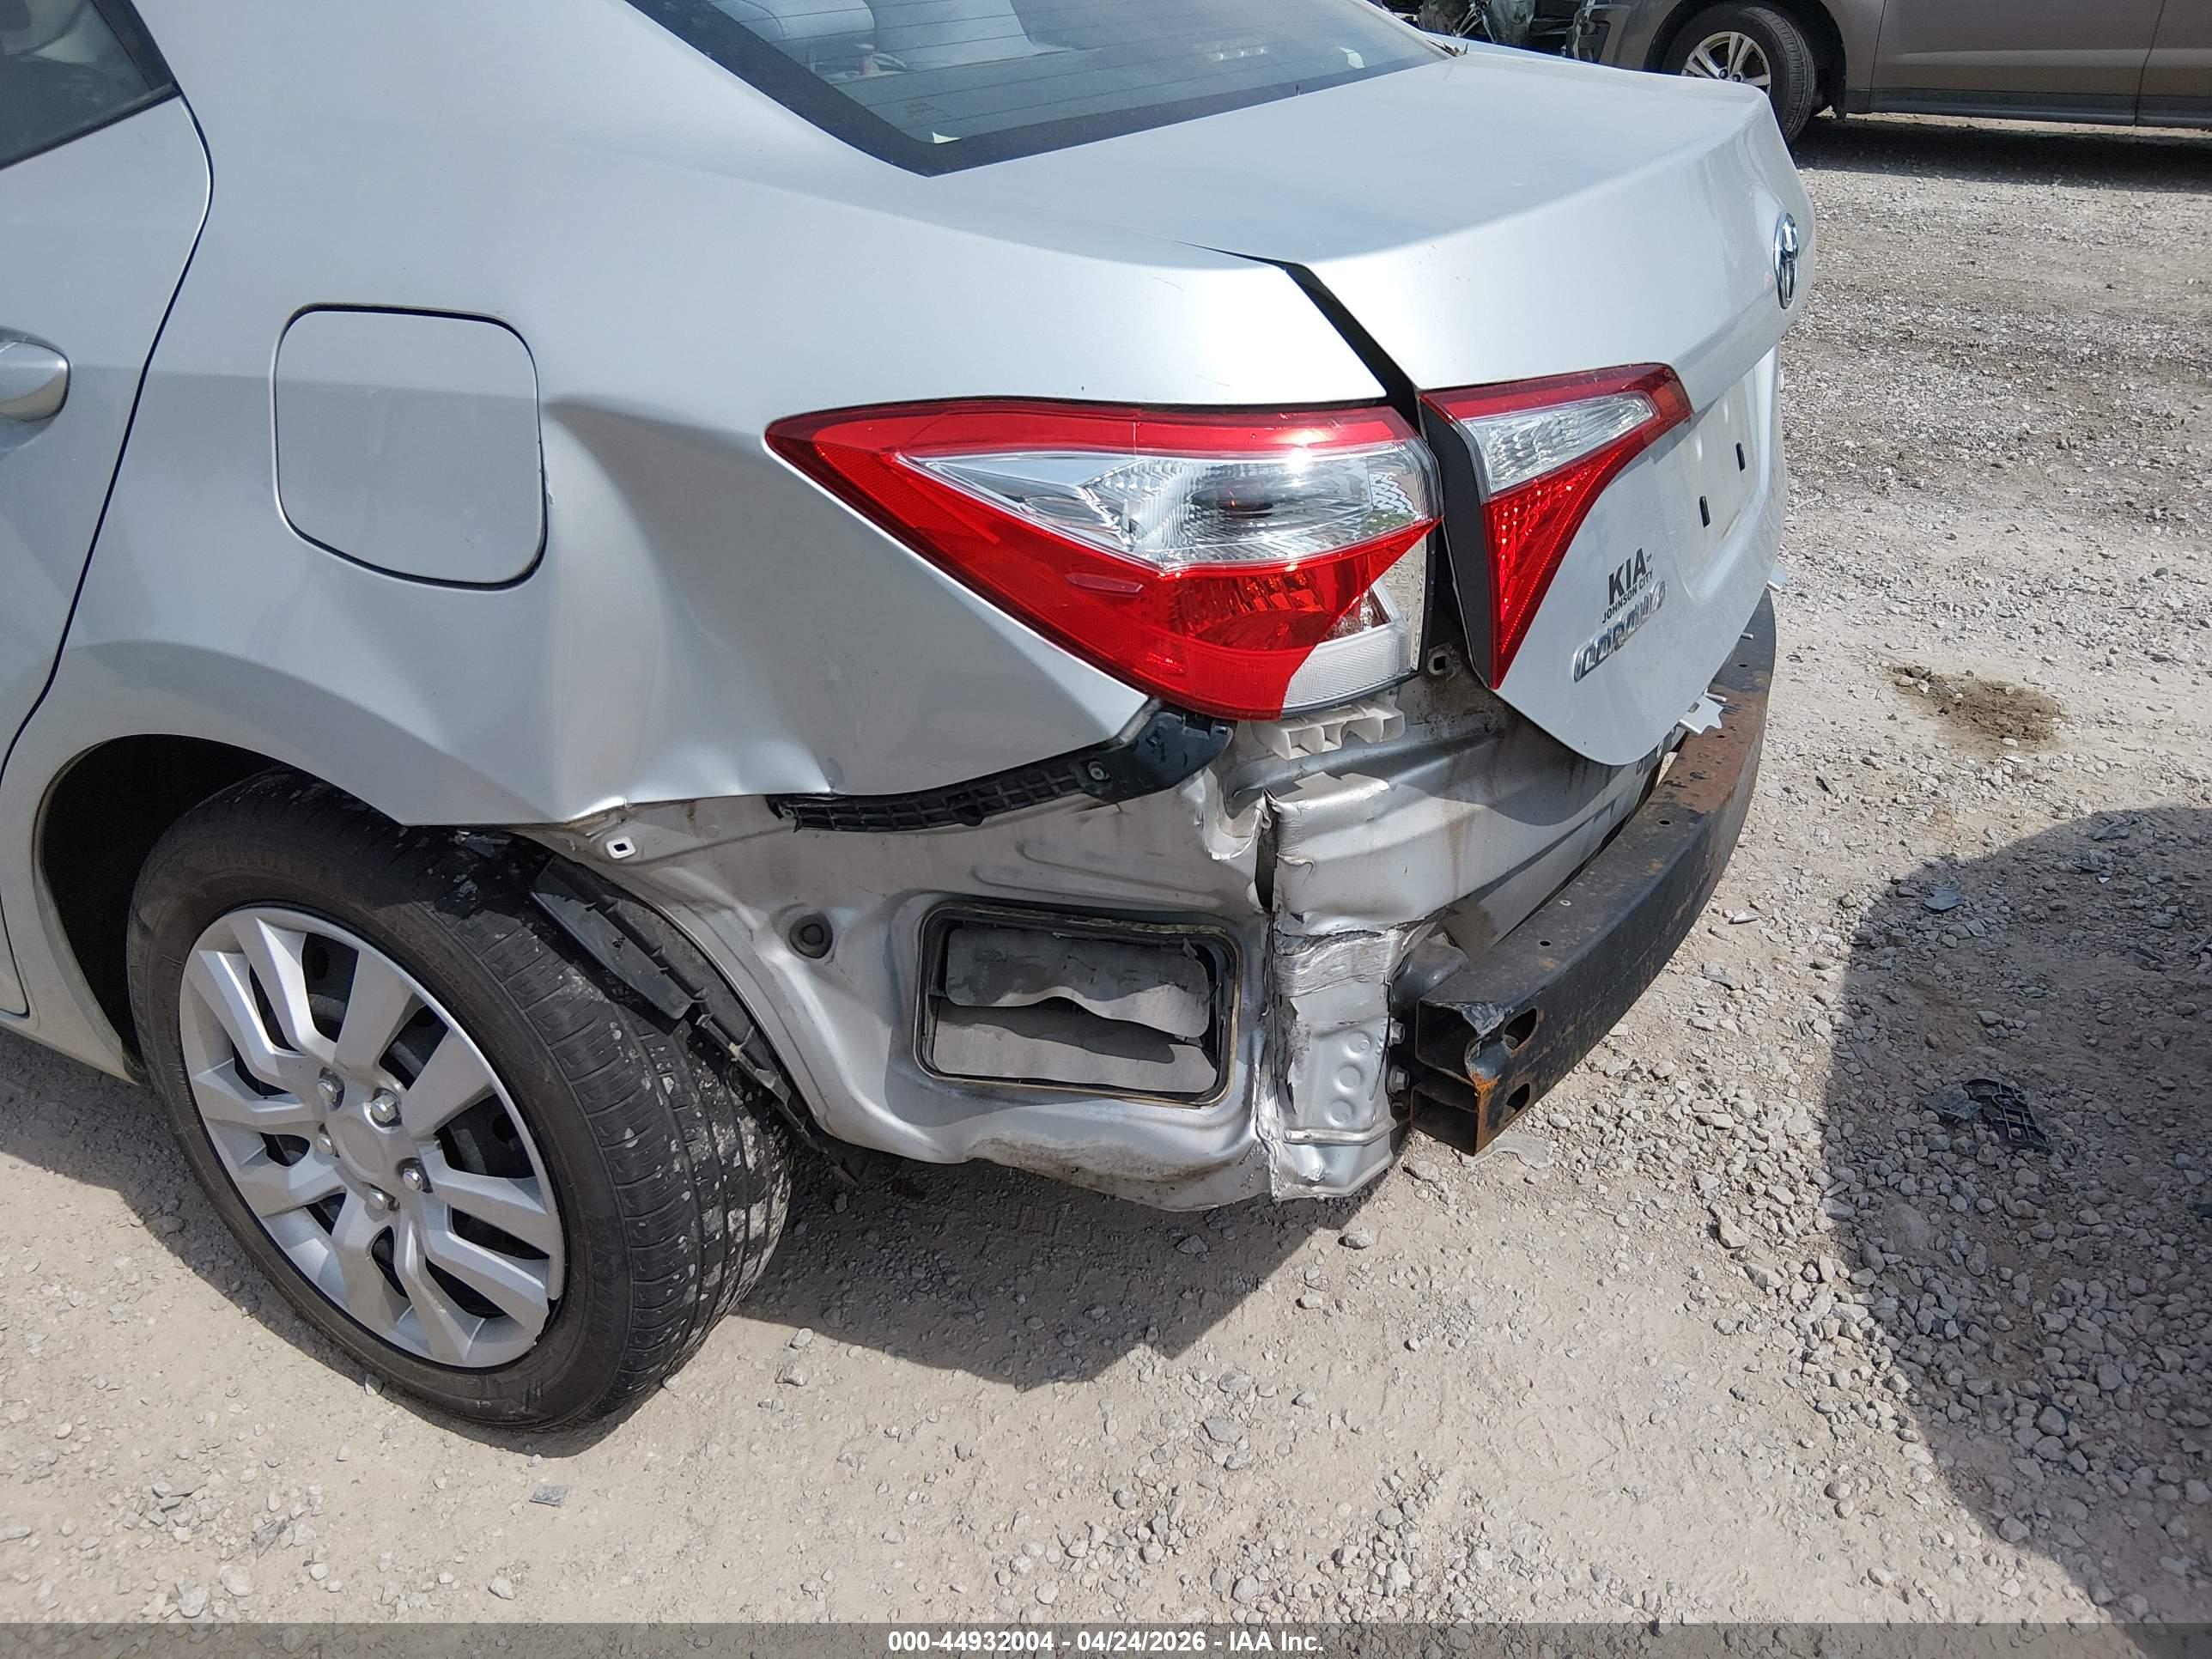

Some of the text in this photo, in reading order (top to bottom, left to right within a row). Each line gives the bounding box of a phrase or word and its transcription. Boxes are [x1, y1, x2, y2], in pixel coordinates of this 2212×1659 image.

[1602, 568, 1654, 624] JOHNSON CITY
[1608, 548, 1647, 605] KIA
